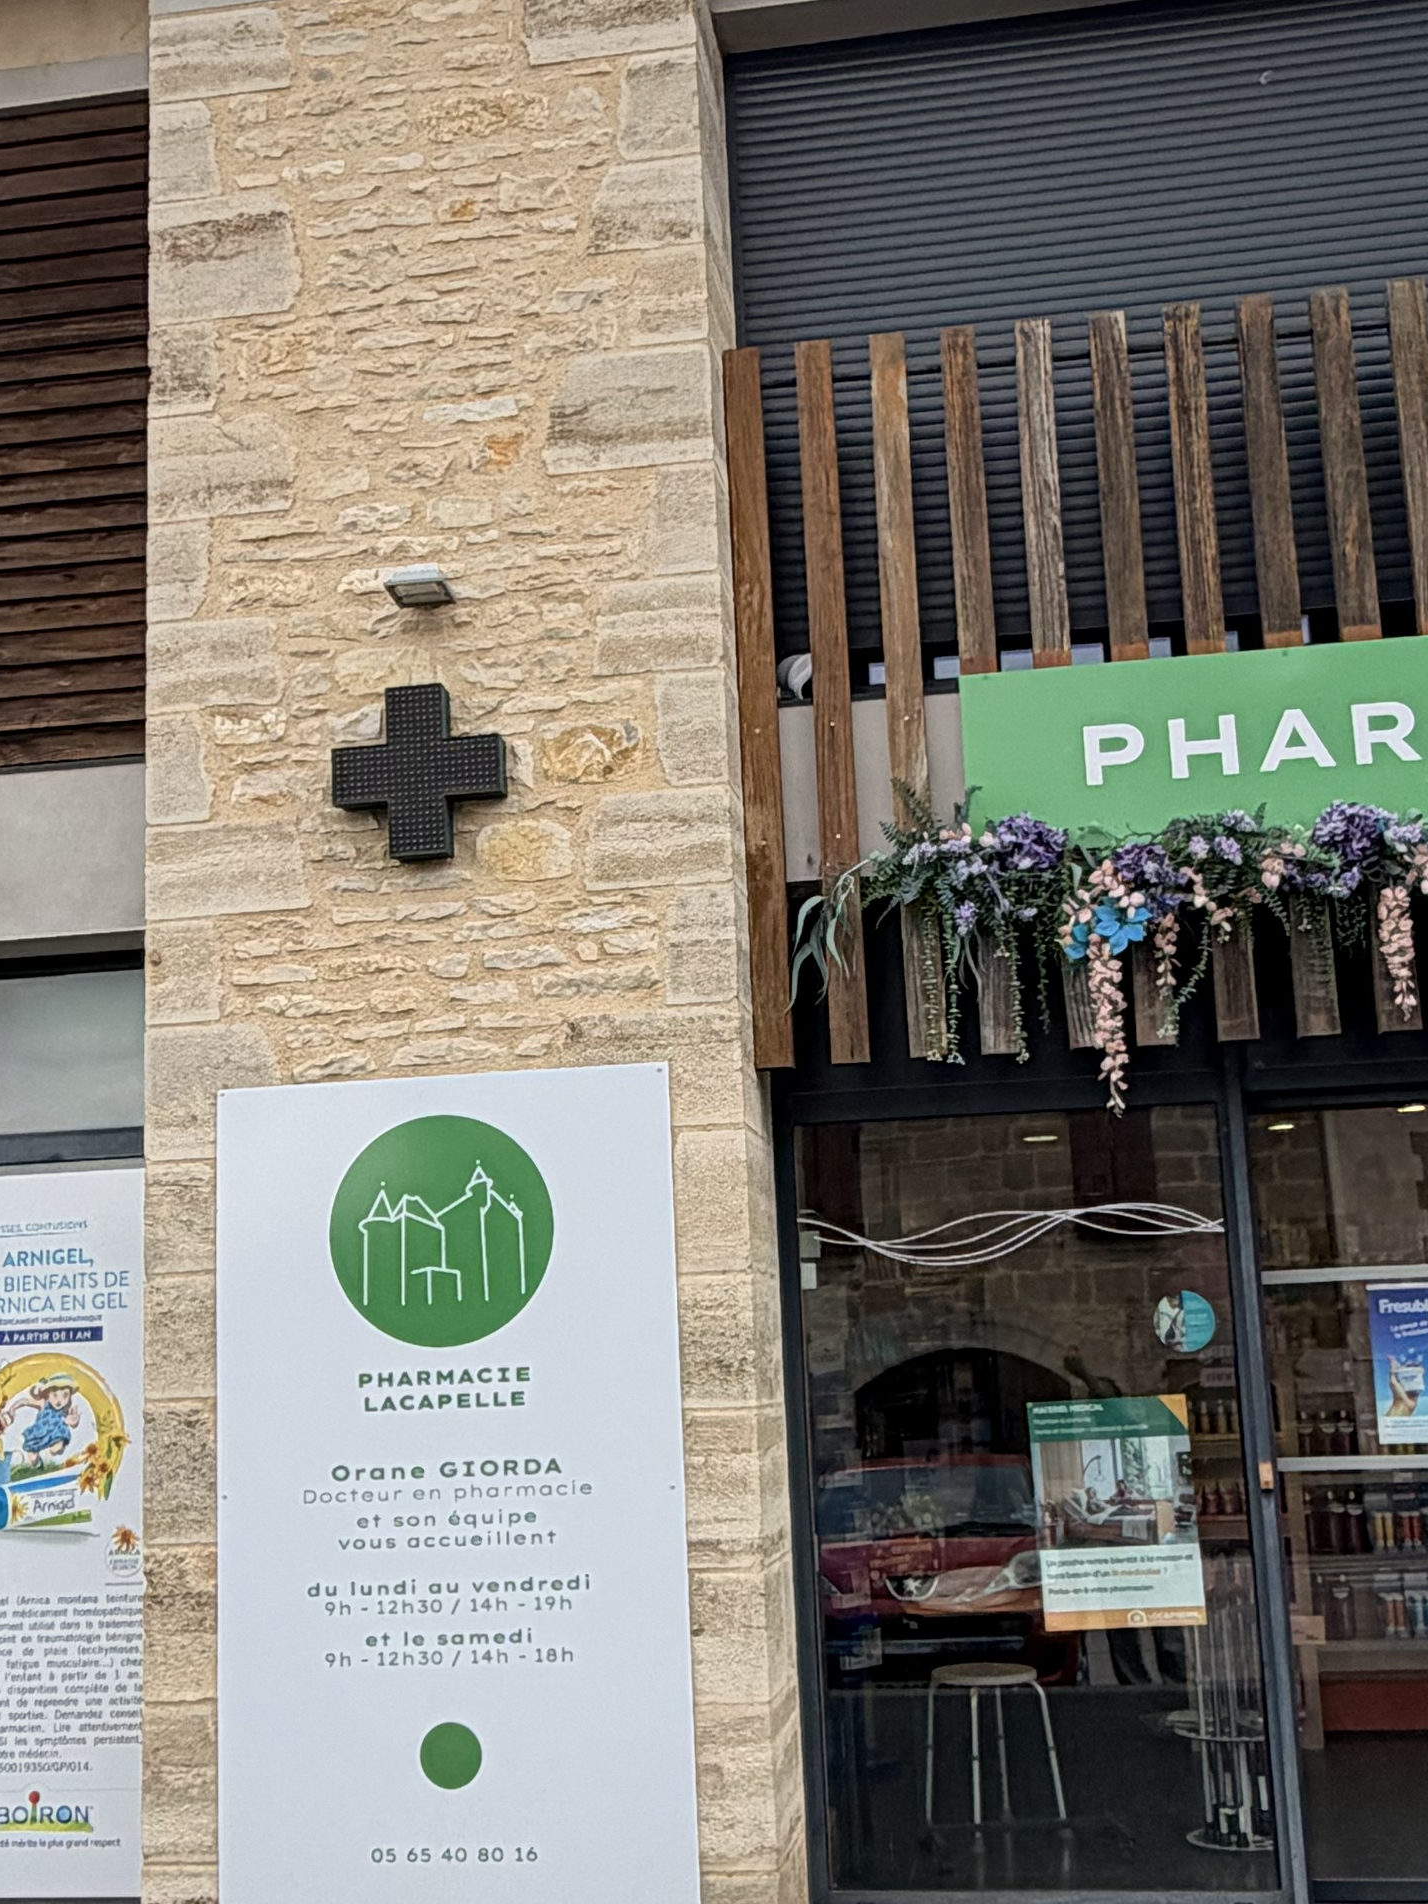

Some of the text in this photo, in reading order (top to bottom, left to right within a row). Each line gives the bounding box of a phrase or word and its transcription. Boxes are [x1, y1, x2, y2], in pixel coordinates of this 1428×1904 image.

[3, 1248, 94, 1268] ARNIGEL,
[4, 1272, 99, 1292] BIENFAITS
[104, 1271, 130, 1287] DE
[61, 1294, 87, 1311] EN
[92, 1292, 127, 1309] GEL
[13, 1332, 49, 1342] PARTIR
[76, 1331, 91, 1339] AN
[358, 1366, 531, 1388] PHARMACIE
[364, 1391, 526, 1412] LACAPELLE
[332, 1458, 562, 1482] Orane GIORDA
[304, 1480, 592, 1504] Docteur en pharmacie
[356, 1510, 537, 1528] et son équipe
[338, 1530, 556, 1550] vous accueillent
[307, 1574, 590, 1597] du lundi au vendredi
[325, 1601, 351, 1616] 9h
[377, 1599, 442, 1614] 12h30
[451, 1599, 460, 1615] /
[470, 1597, 508, 1612] 14h
[534, 1596, 572, 1611] 19h
[366, 1628, 532, 1647] et le samedi
[325, 1652, 352, 1667] 9h
[377, 1650, 444, 1666] 12h30
[452, 1650, 460, 1667] /
[471, 1649, 508, 1664] 14h
[535, 1648, 574, 1663] 18h
[371, 1847, 538, 1863] 05 65 40 80 16
